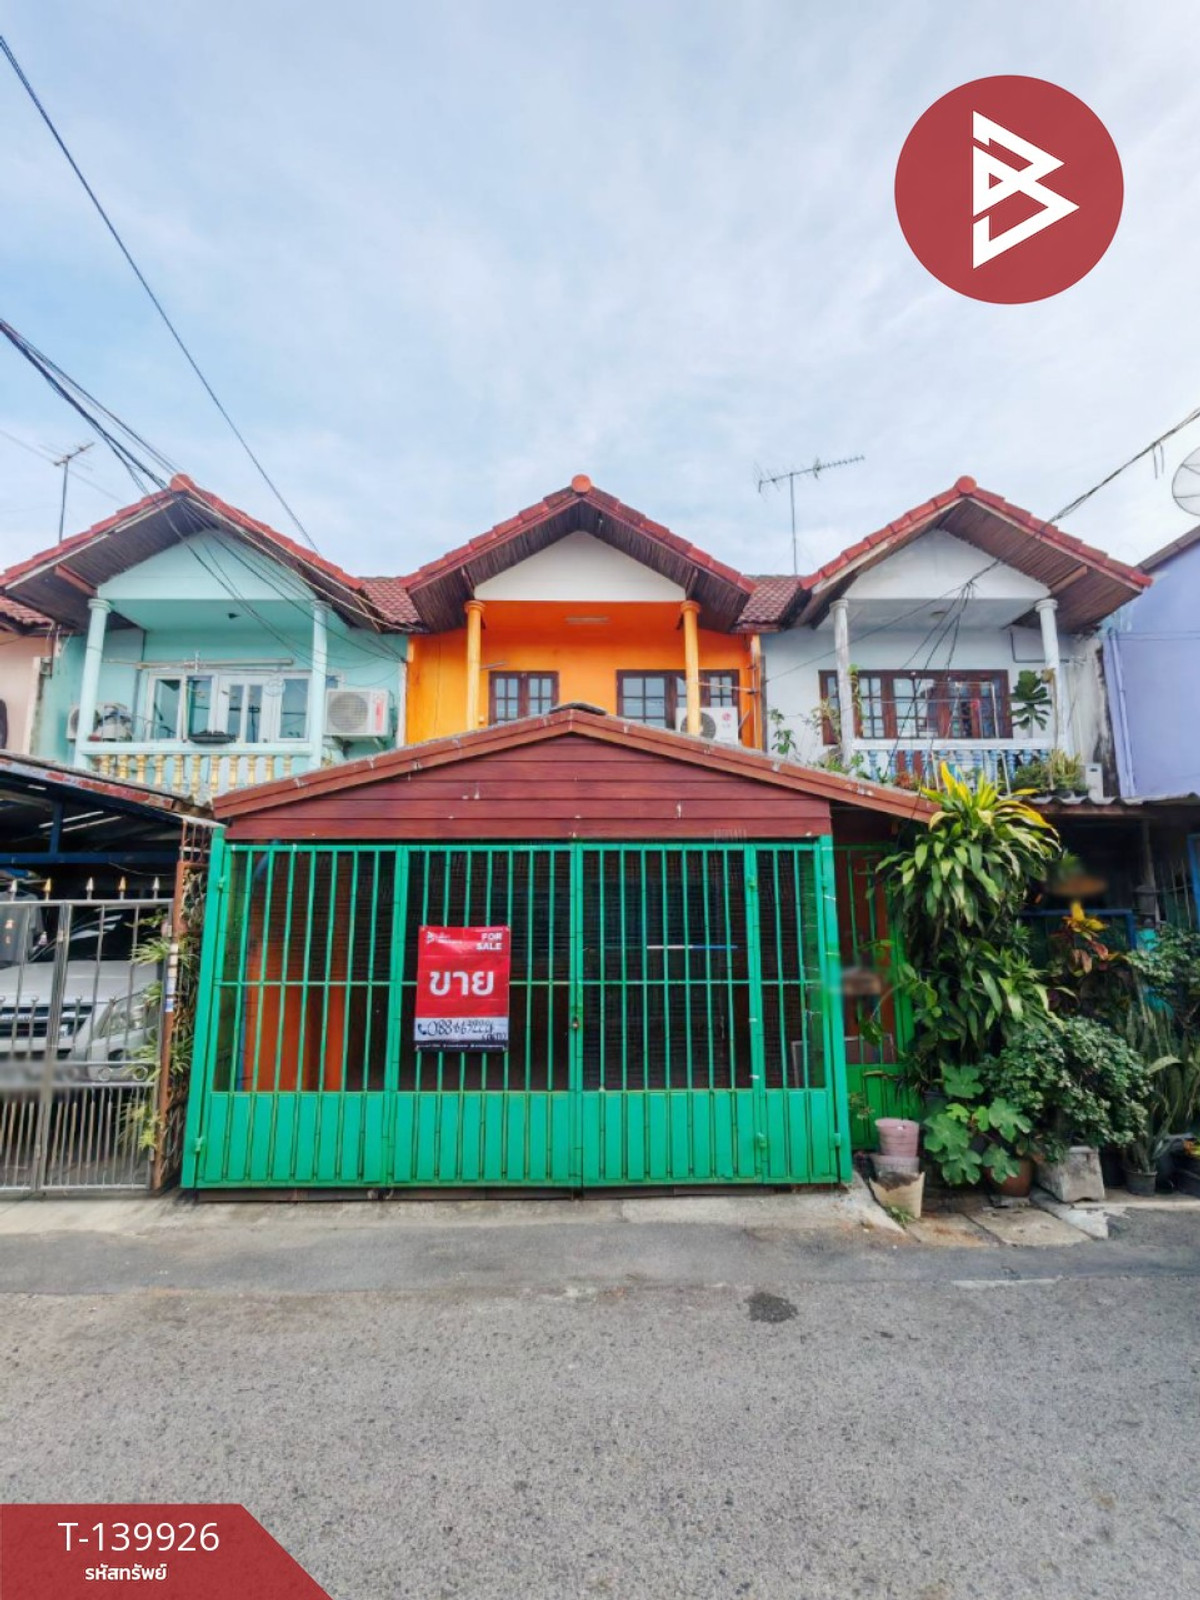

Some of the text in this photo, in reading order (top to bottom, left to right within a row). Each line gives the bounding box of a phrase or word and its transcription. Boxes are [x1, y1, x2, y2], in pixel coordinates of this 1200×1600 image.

[482, 932, 503, 941] FOR
[476, 942, 502, 951] SALE
[430, 971, 494, 996] ขาย
